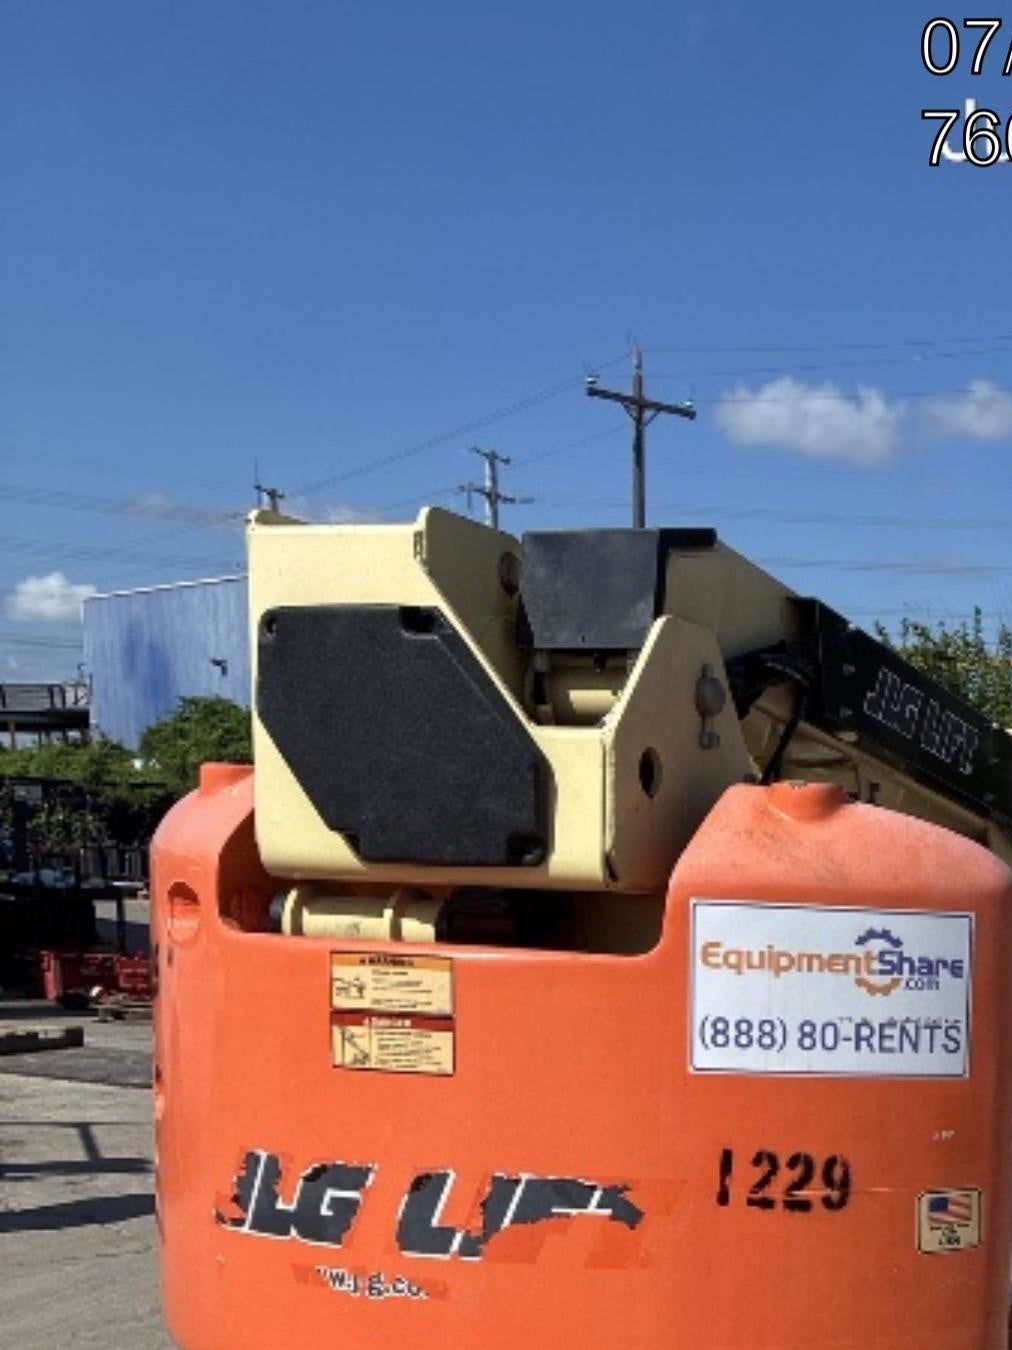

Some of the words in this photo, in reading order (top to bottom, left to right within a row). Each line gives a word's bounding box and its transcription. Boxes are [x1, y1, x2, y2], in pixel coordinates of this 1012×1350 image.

[700, 941, 965, 979] EquipmentShare
[700, 1014, 788, 1055] (888)
[797, 1017, 962, 1056] 80-RENTS
[716, 1147, 852, 1213] 1229
